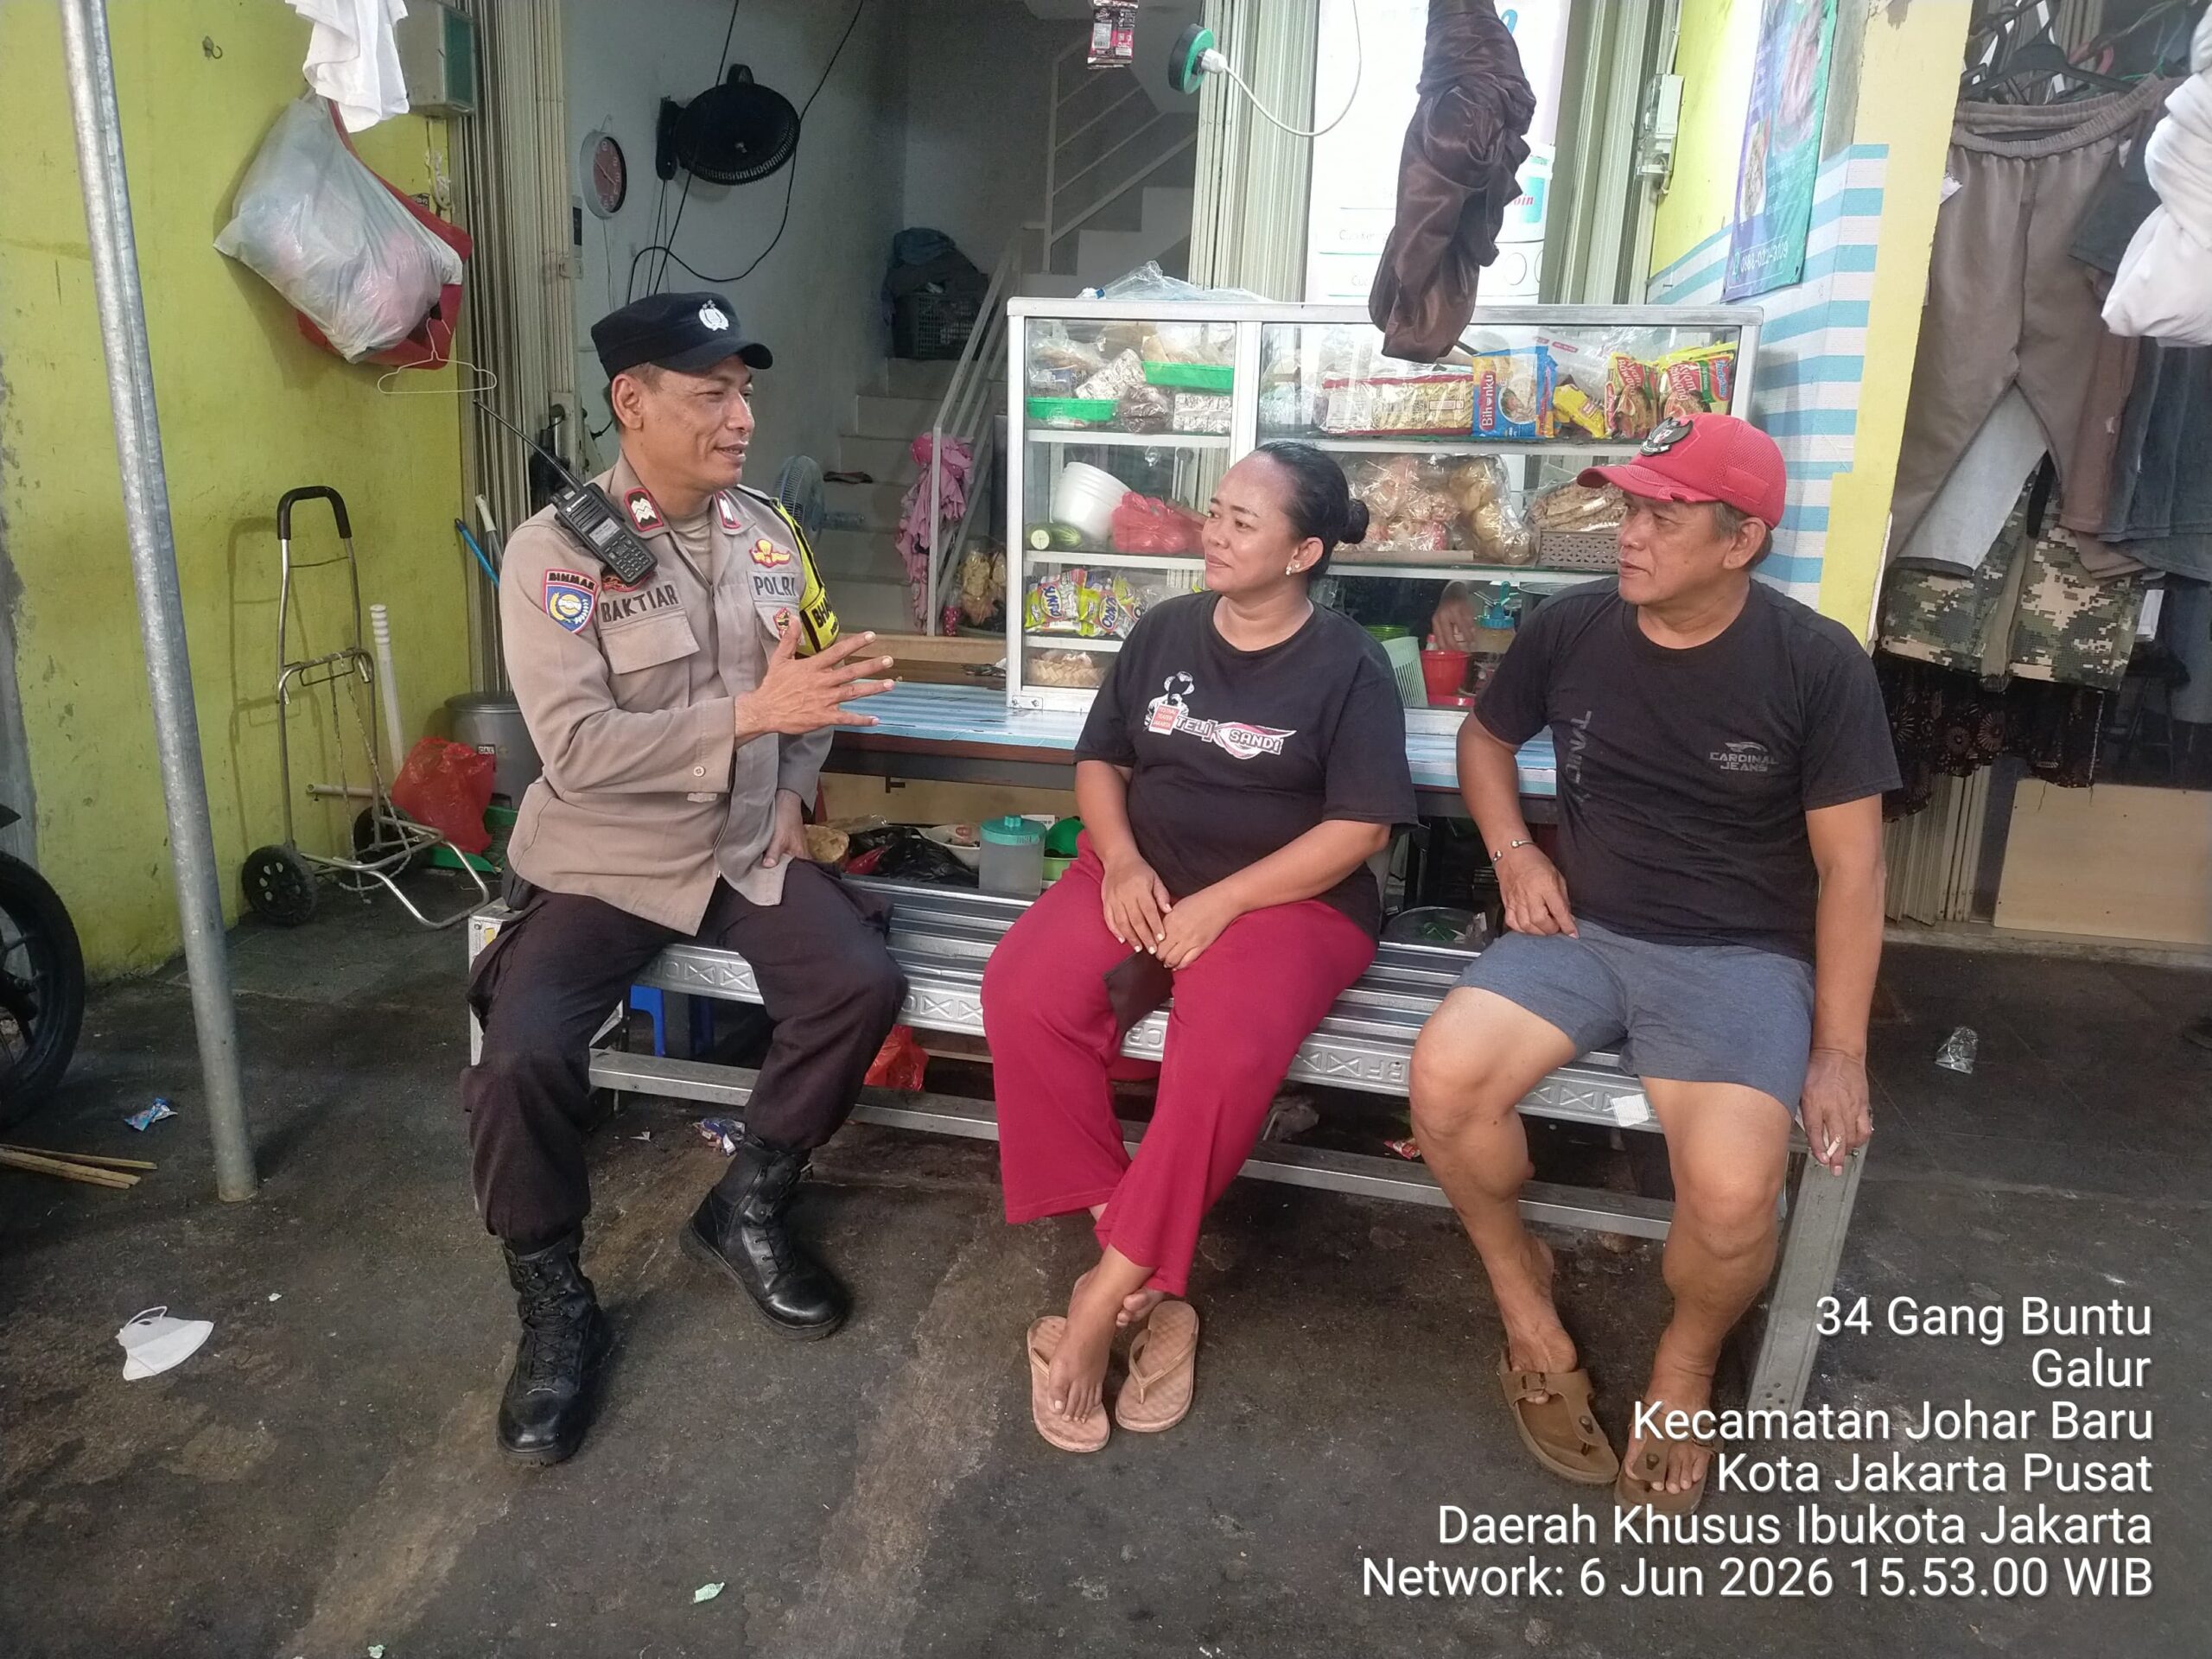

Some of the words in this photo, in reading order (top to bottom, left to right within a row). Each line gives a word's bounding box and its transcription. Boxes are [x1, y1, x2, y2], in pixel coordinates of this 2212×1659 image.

[548, 572, 594, 590] BINMAS
[753, 575, 797, 596] POLRI
[600, 583, 679, 623] BAKTIAR
[1230, 728, 1284, 753] SANDI
[1710, 752, 1778, 765] CARDINAL
[1720, 761, 1768, 772] JEANS
